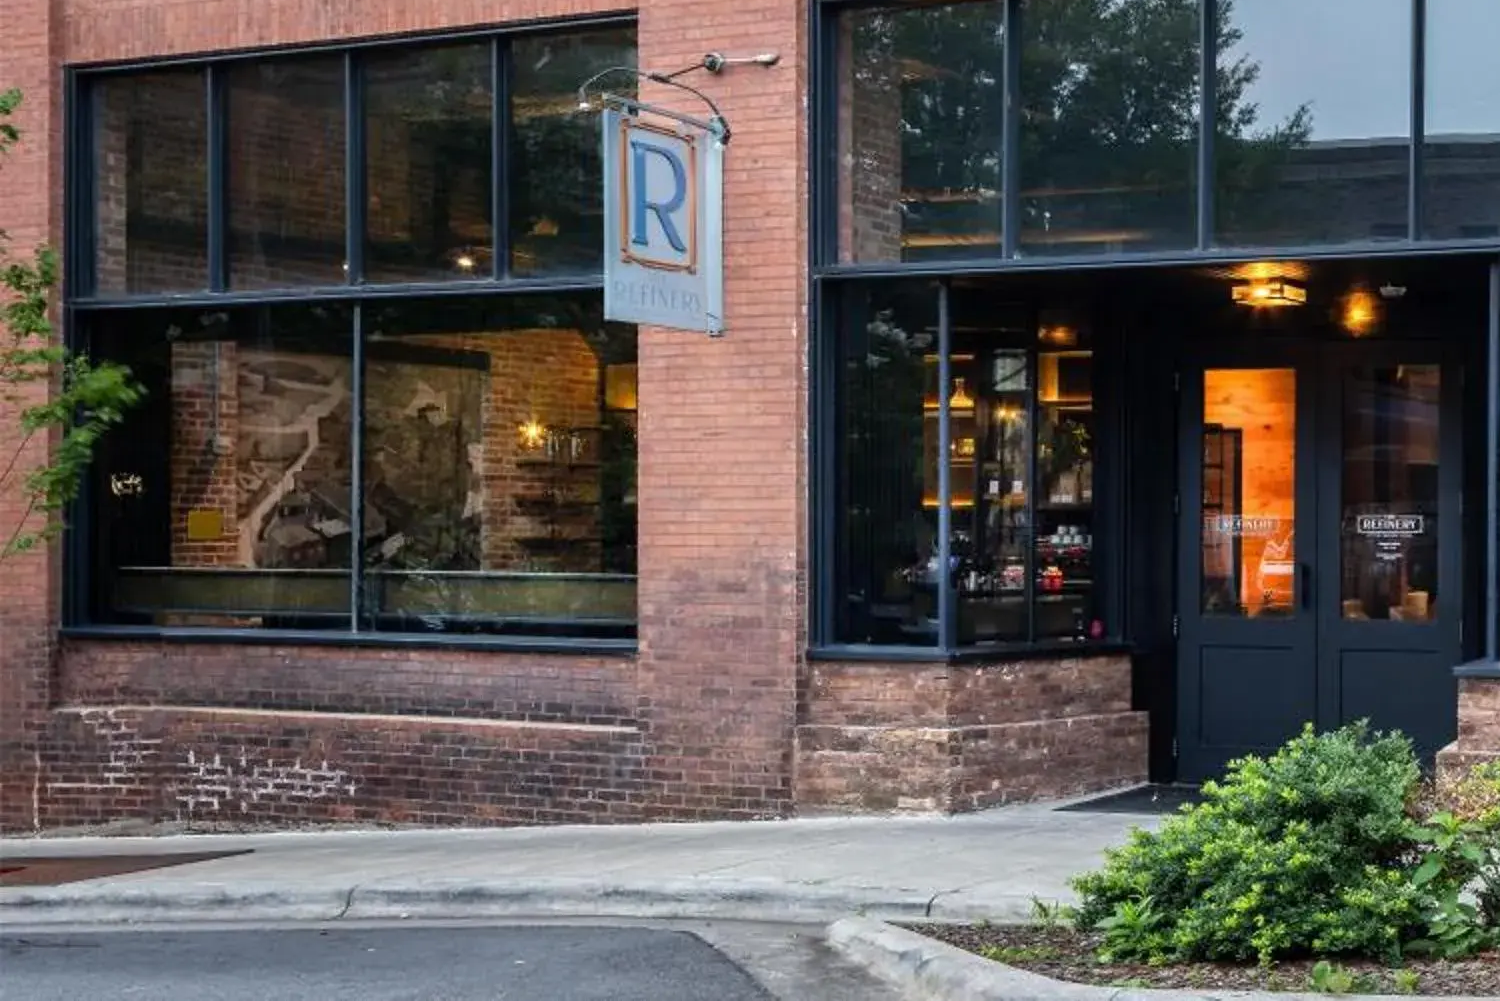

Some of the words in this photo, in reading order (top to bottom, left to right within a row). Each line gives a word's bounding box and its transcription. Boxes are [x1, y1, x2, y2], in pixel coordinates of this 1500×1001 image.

[630, 140, 687, 254] R
[614, 280, 703, 315] REFINERY
[1363, 518, 1417, 529] REFINERY
